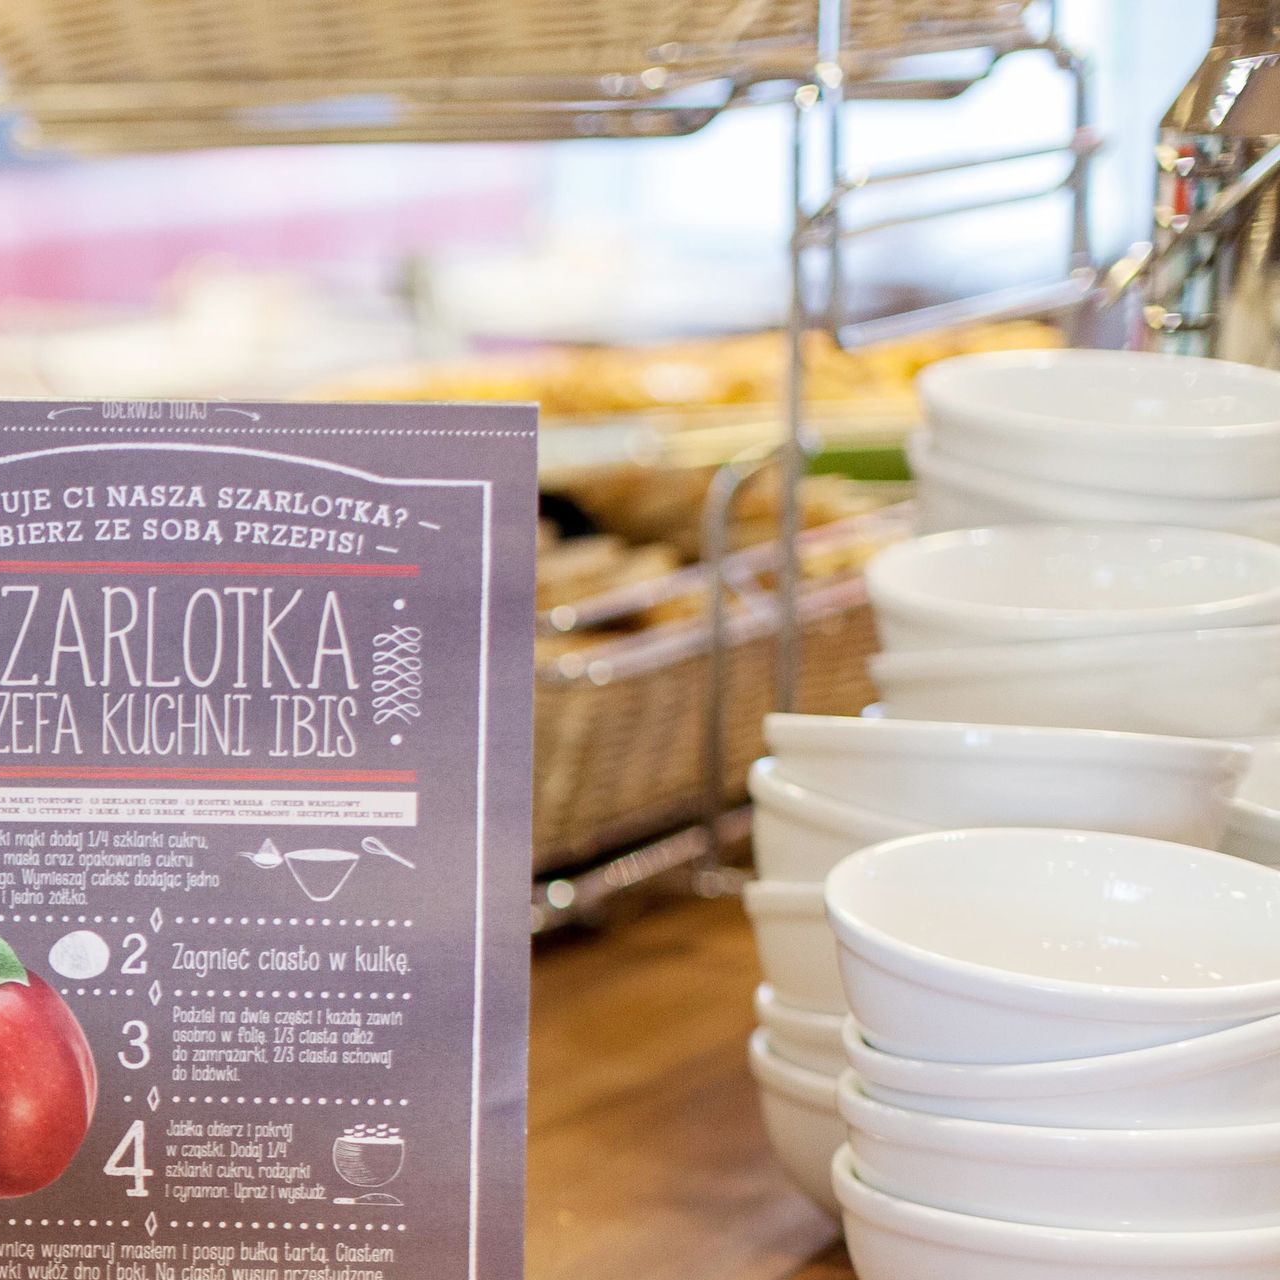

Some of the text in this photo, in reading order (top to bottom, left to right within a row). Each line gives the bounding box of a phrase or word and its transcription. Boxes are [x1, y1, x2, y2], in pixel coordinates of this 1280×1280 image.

[63, 486, 96, 509] CI
[106, 484, 207, 508] NASZA
[217, 487, 409, 529] SZARLOTKA?
[94, 518, 131, 541] ZE
[142, 518, 223, 545] SOBĄ
[233, 521, 365, 556] PRZEPIS!
[102, 692, 252, 756] KUCHNI
[268, 694, 358, 758] IBIS
[15, 829, 45, 848] mąki
[49, 830, 83, 851] dodaj
[87, 830, 109, 847] 1/4
[112, 830, 164, 848] szklanki
[3, 849, 40, 866] masła
[44, 852, 74, 866] oraz
[78, 850, 151, 871] opakowanie
[155, 850, 194, 867] cukru
[21, 868, 87, 890] Wymieszaj
[91, 869, 130, 886] całość
[134, 869, 182, 892] dodając
[184, 870, 220, 892] jedno
[1, 889, 6, 903] i
[9, 887, 44, 909] jedno
[121, 933, 148, 975] 2
[171, 943, 412, 978] Zagnieć ciasto w kulkę.
[172, 1006, 403, 1027] Podziel na dwie części i każdą zawiń
[117, 1019, 151, 1070] 3
[172, 1026, 216, 1043] osobno
[220, 1031, 233, 1043] w
[272, 1026, 295, 1044] 1/3
[298, 1027, 338, 1044] ciasta
[342, 1027, 374, 1045] odłóż
[171, 1045, 188, 1062] do
[272, 1046, 295, 1063] 2/3
[298, 1047, 338, 1064] ciasta
[342, 1047, 392, 1069] schowaj
[171, 1064, 241, 1082] do lodówki.
[165, 1119, 294, 1142] Jabłka obierz i pokrój
[103, 1119, 155, 1197] 4
[165, 1143, 176, 1157] w
[230, 1141, 264, 1162] Dodaj
[266, 1141, 287, 1158] 1/4
[165, 1161, 213, 1178] szklanki
[258, 1162, 311, 1183] rodzynki
[164, 1184, 169, 1198] i
[270, 1185, 275, 1199] i
[41, 1242, 116, 1264] wysmaruj
[120, 1240, 177, 1260] masłem
[182, 1243, 188, 1260] i
[192, 1248, 236, 1266] posyp
[240, 1241, 278, 1264] bułką
[284, 1242, 330, 1264] tartą.
[335, 1242, 394, 1263] Ciastem
[73, 1261, 101, 1280] dno
[106, 1264, 111, 1280] i
[116, 1261, 150, 1280] boki.
